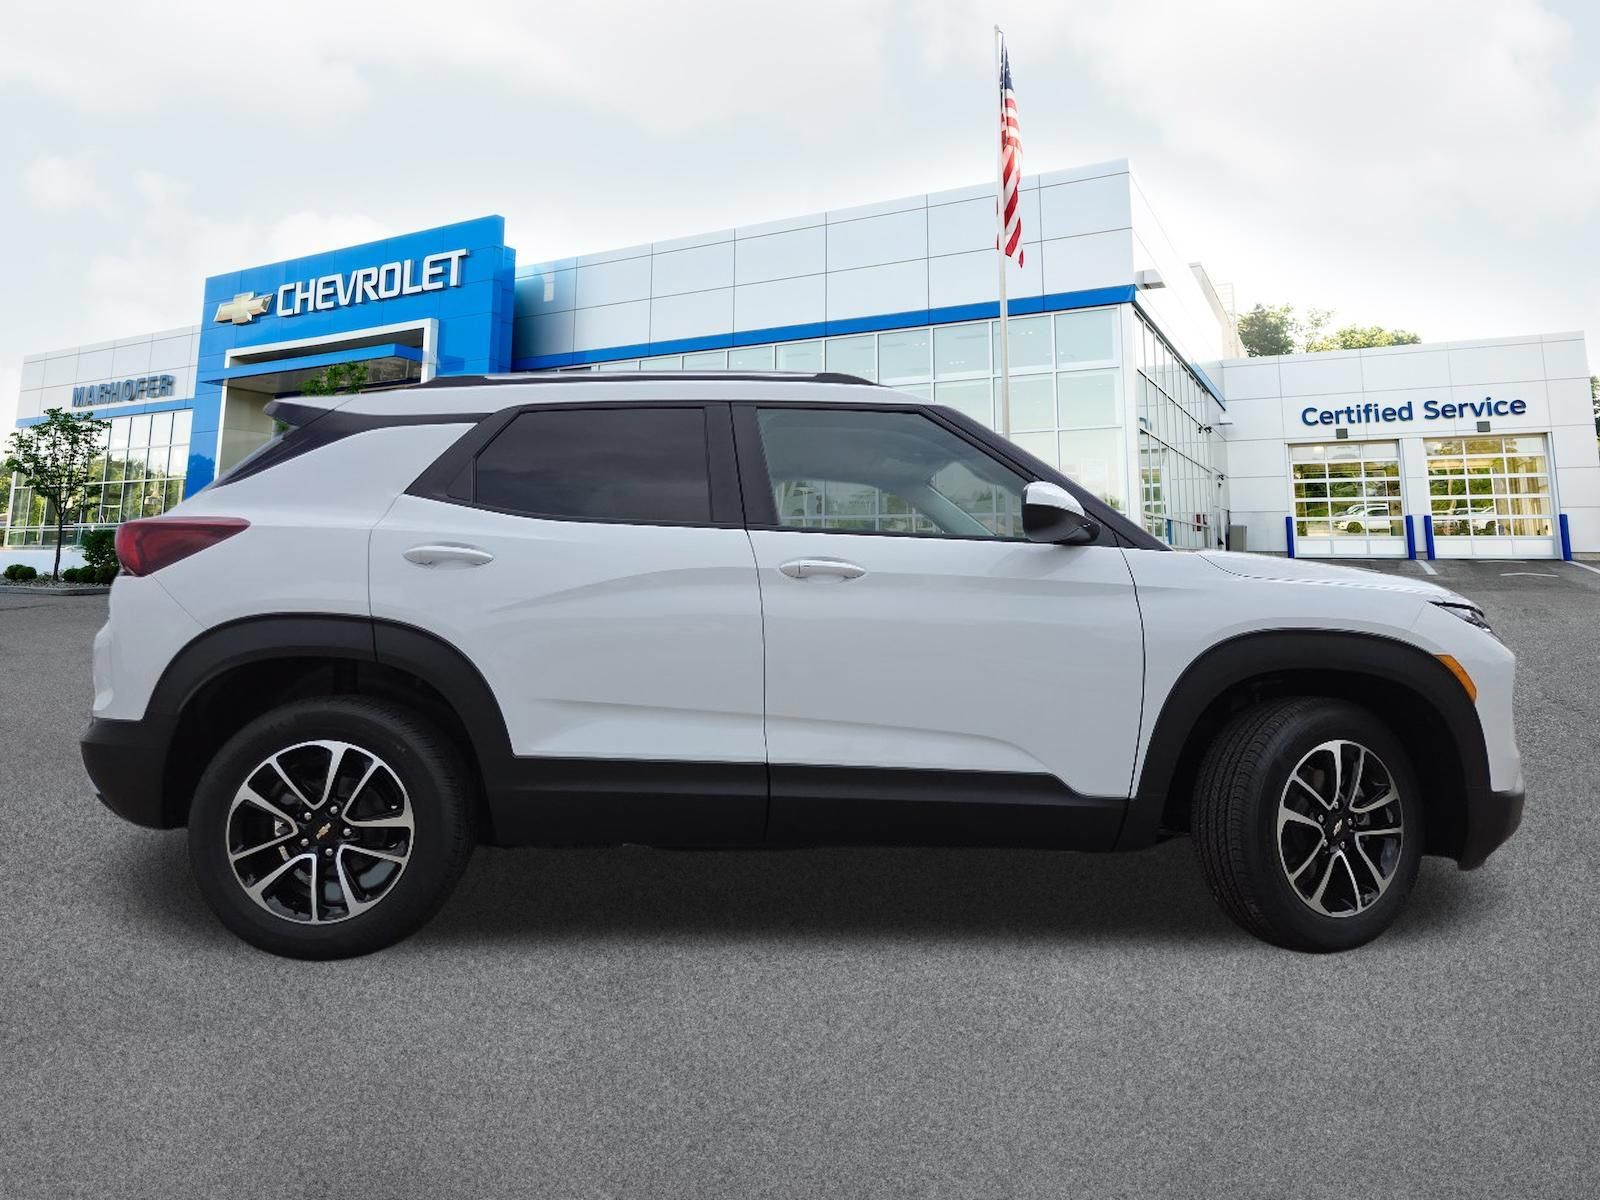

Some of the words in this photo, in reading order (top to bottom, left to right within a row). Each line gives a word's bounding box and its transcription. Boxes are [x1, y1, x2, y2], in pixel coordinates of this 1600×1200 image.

[276, 248, 469, 317] CHEVROLET
[72, 375, 174, 407] MARHOFER
[1301, 401, 1413, 426] Certified
[1424, 396, 1527, 420] Service
